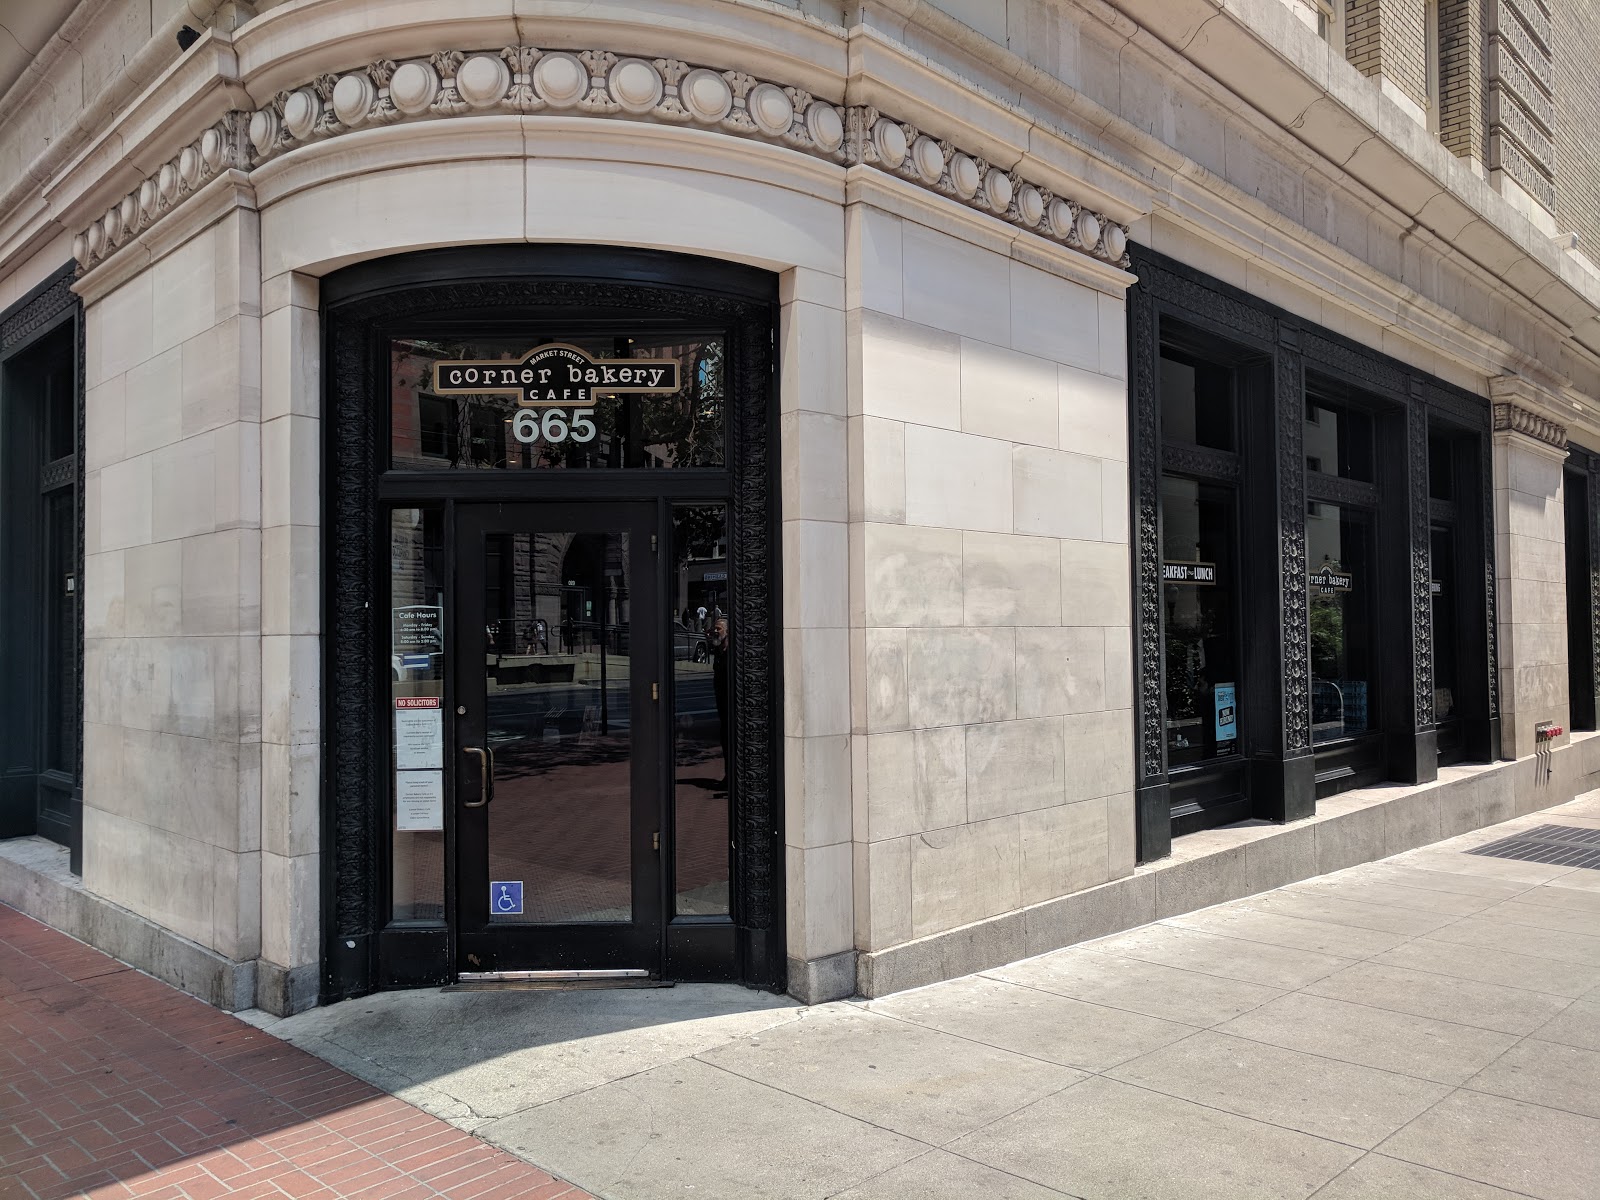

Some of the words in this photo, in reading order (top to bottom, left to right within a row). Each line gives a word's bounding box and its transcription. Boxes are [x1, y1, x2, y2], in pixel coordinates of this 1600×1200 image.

[529, 350, 558, 366] MARKET
[559, 350, 585, 365] STREET
[449, 367, 552, 385] corner
[567, 364, 665, 387] bakery
[529, 389, 586, 400] CAFE
[512, 408, 597, 443] 665
[1163, 565, 1188, 579] EAKFAST
[1194, 566, 1213, 580] LUNCH
[1309, 575, 1326, 585] rner
[1328, 574, 1350, 588] bakery
[398, 699, 406, 707] NO
[407, 698, 437, 707] SOLICITORS
